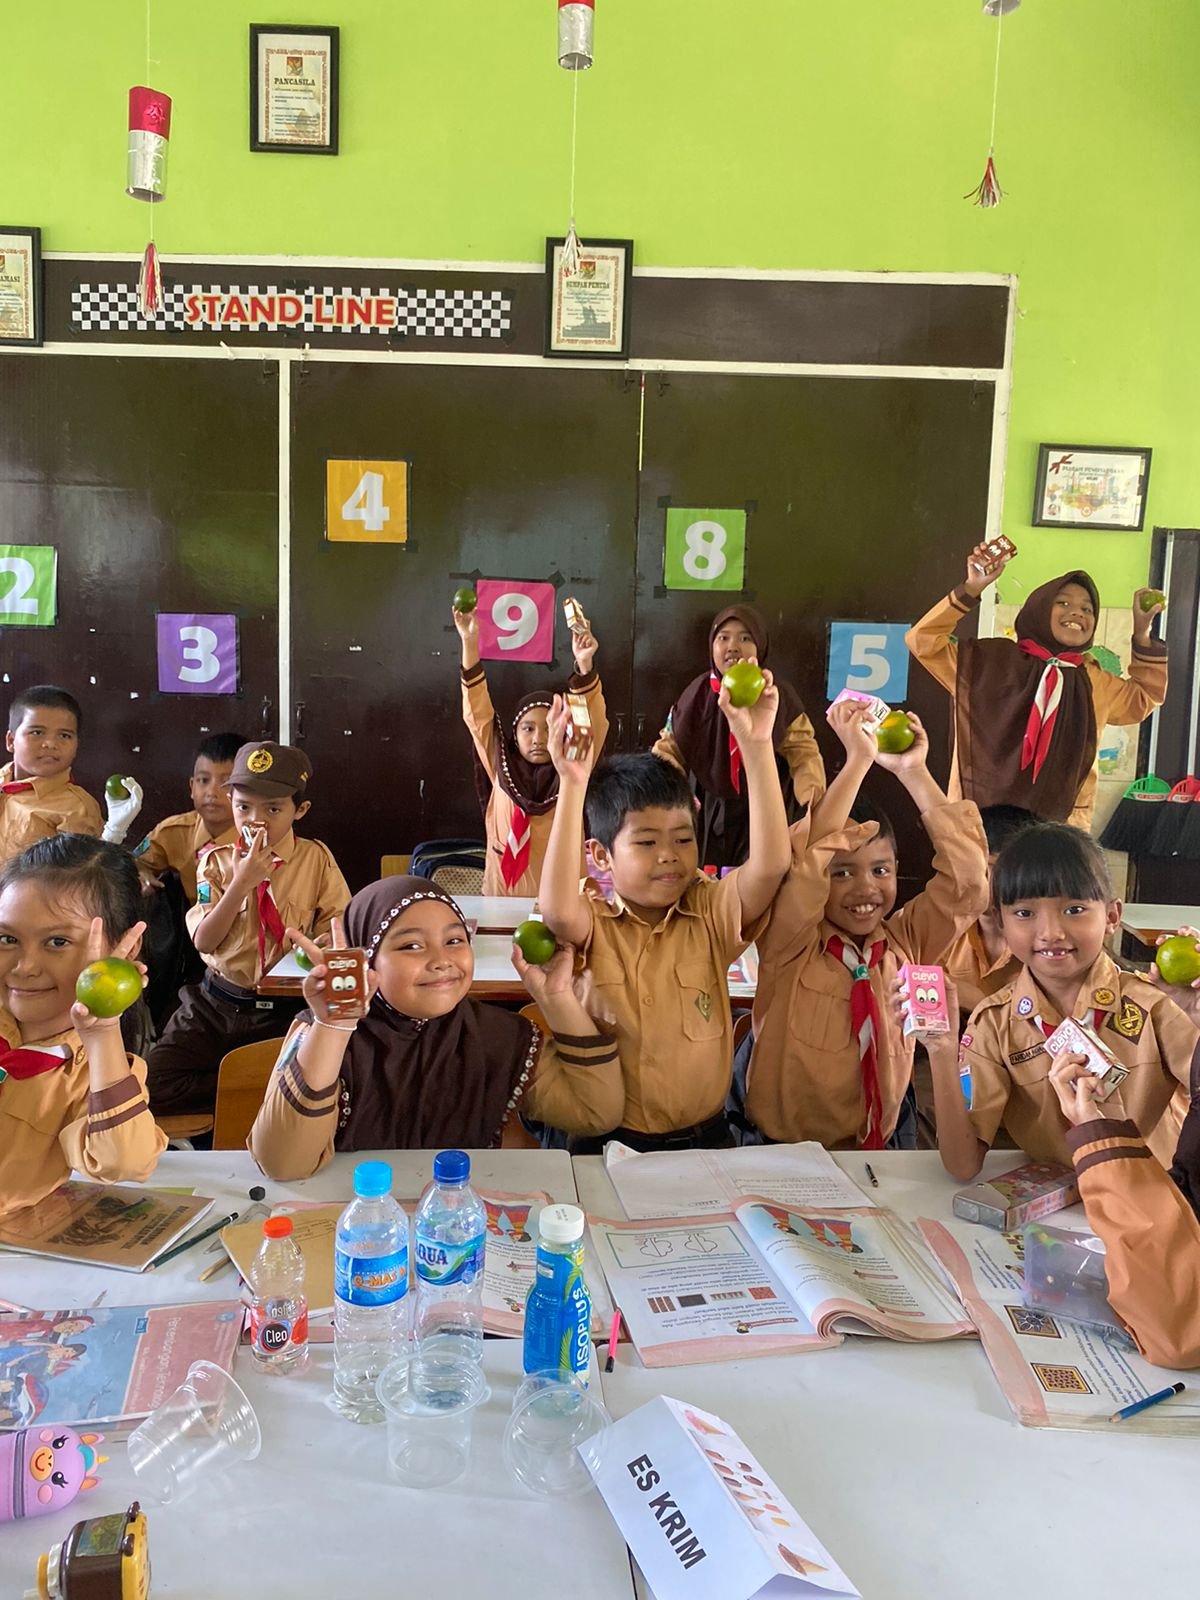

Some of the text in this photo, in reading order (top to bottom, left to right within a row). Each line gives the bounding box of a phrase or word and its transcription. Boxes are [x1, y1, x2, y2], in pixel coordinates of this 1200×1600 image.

[274, 77, 315, 87] PANCASILA
[186, 295, 395, 325] STAND LINE
[342, 471, 390, 531] 4
[682, 520, 728, 581] 8
[0, 557, 39, 615] 2
[491, 593, 539, 651] 9
[178, 626, 220, 683] 3
[846, 634, 890, 692] 5
[265, 1329, 288, 1343] Cleo
[573, 1287, 589, 1367] ISOPLUS
[626, 1453, 707, 1570] ES KRIM
